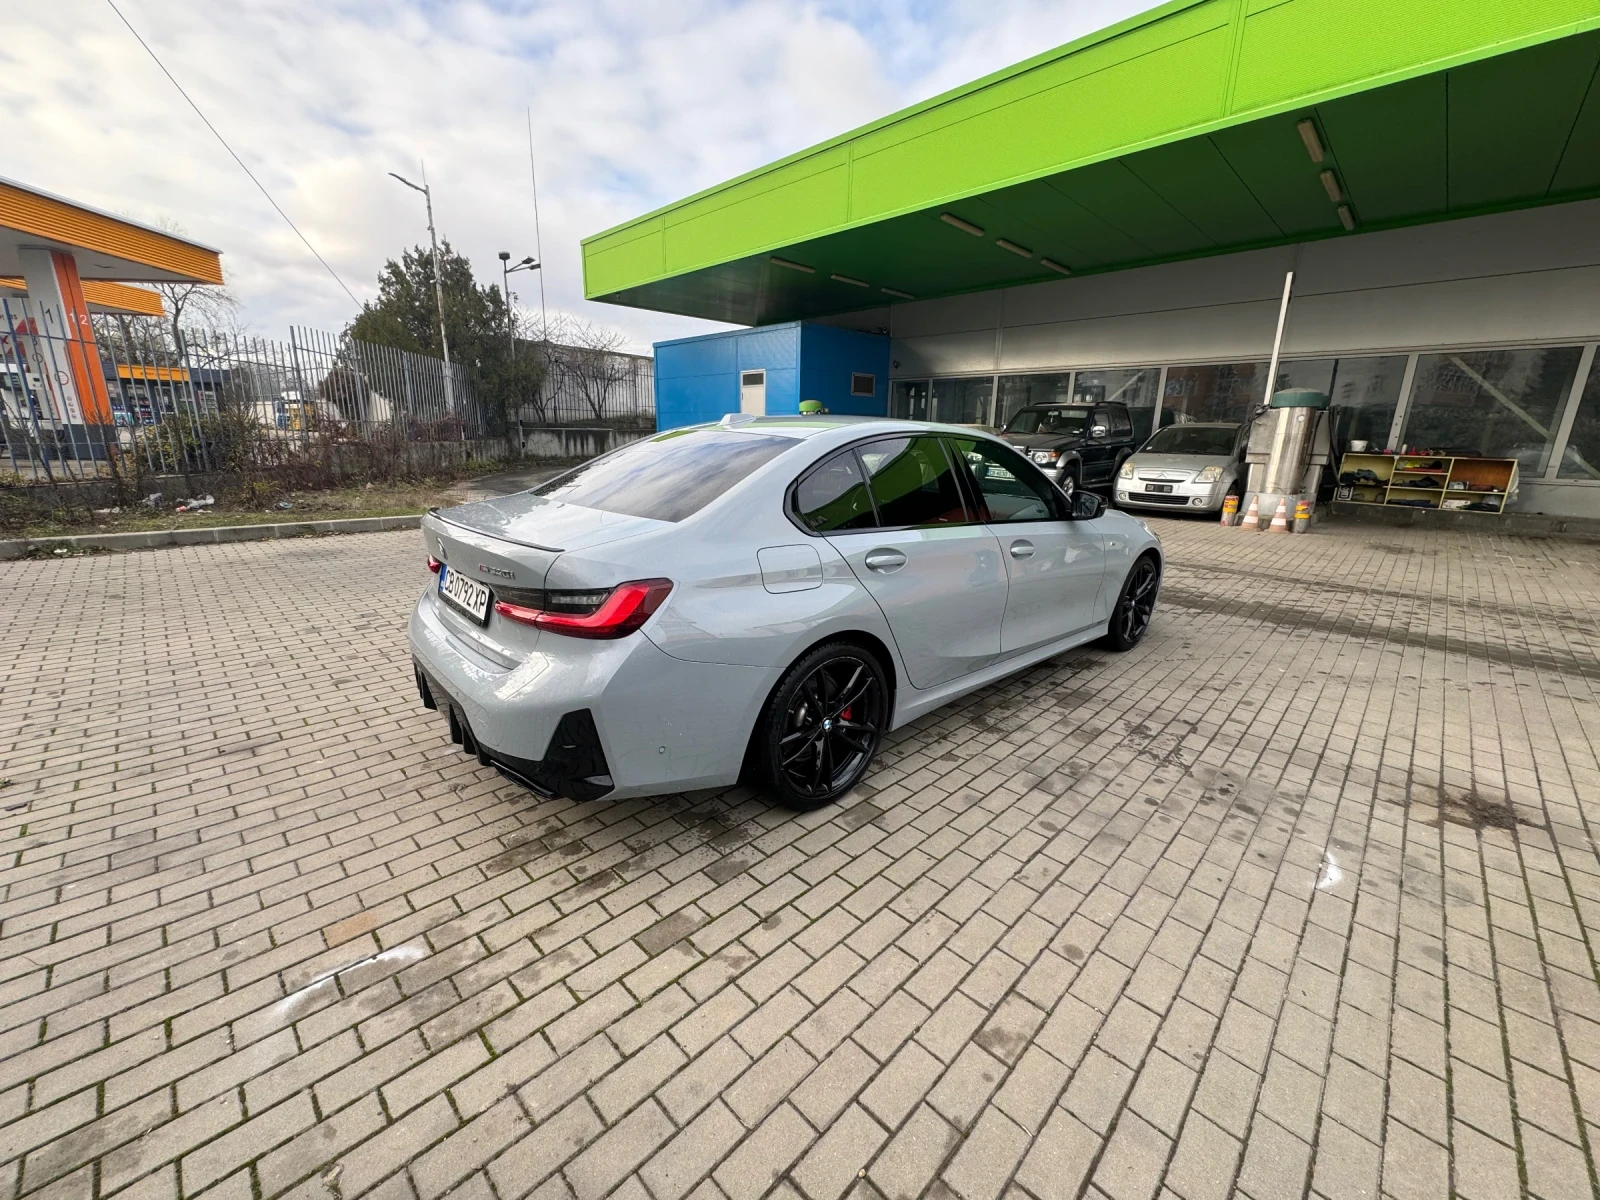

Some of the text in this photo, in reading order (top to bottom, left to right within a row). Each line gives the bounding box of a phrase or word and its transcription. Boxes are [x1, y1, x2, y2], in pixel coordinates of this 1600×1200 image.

[45, 308, 54, 324] 1
[80, 314, 89, 326] 2
[444, 570, 454, 594] CB
[453, 575, 474, 607] 0792
[473, 586, 487, 613] XP
